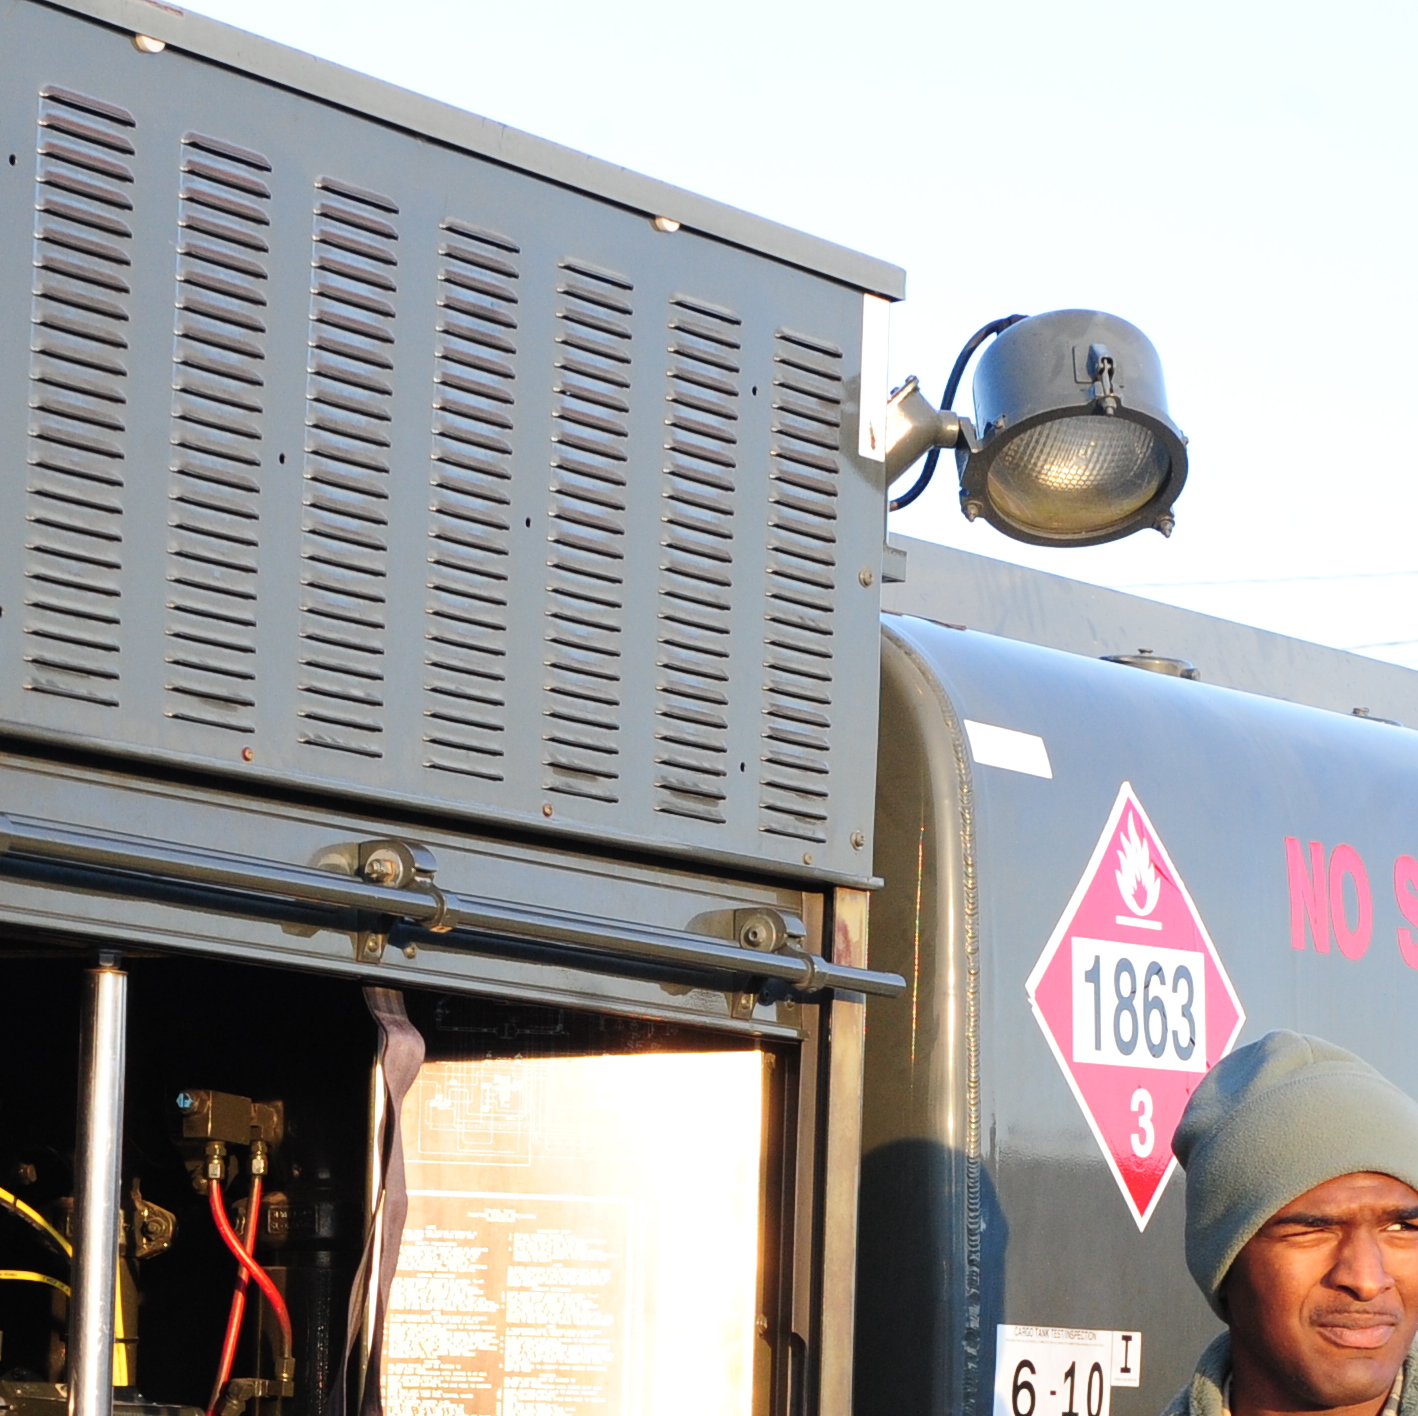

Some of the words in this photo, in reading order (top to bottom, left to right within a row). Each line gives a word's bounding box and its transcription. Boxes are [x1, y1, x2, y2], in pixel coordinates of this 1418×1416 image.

[1284, 835, 1374, 961] NO
[1083, 953, 1199, 1063] 1863
[1128, 1087, 1156, 1159] 3
[1034, 1327, 1050, 1339] TANK
